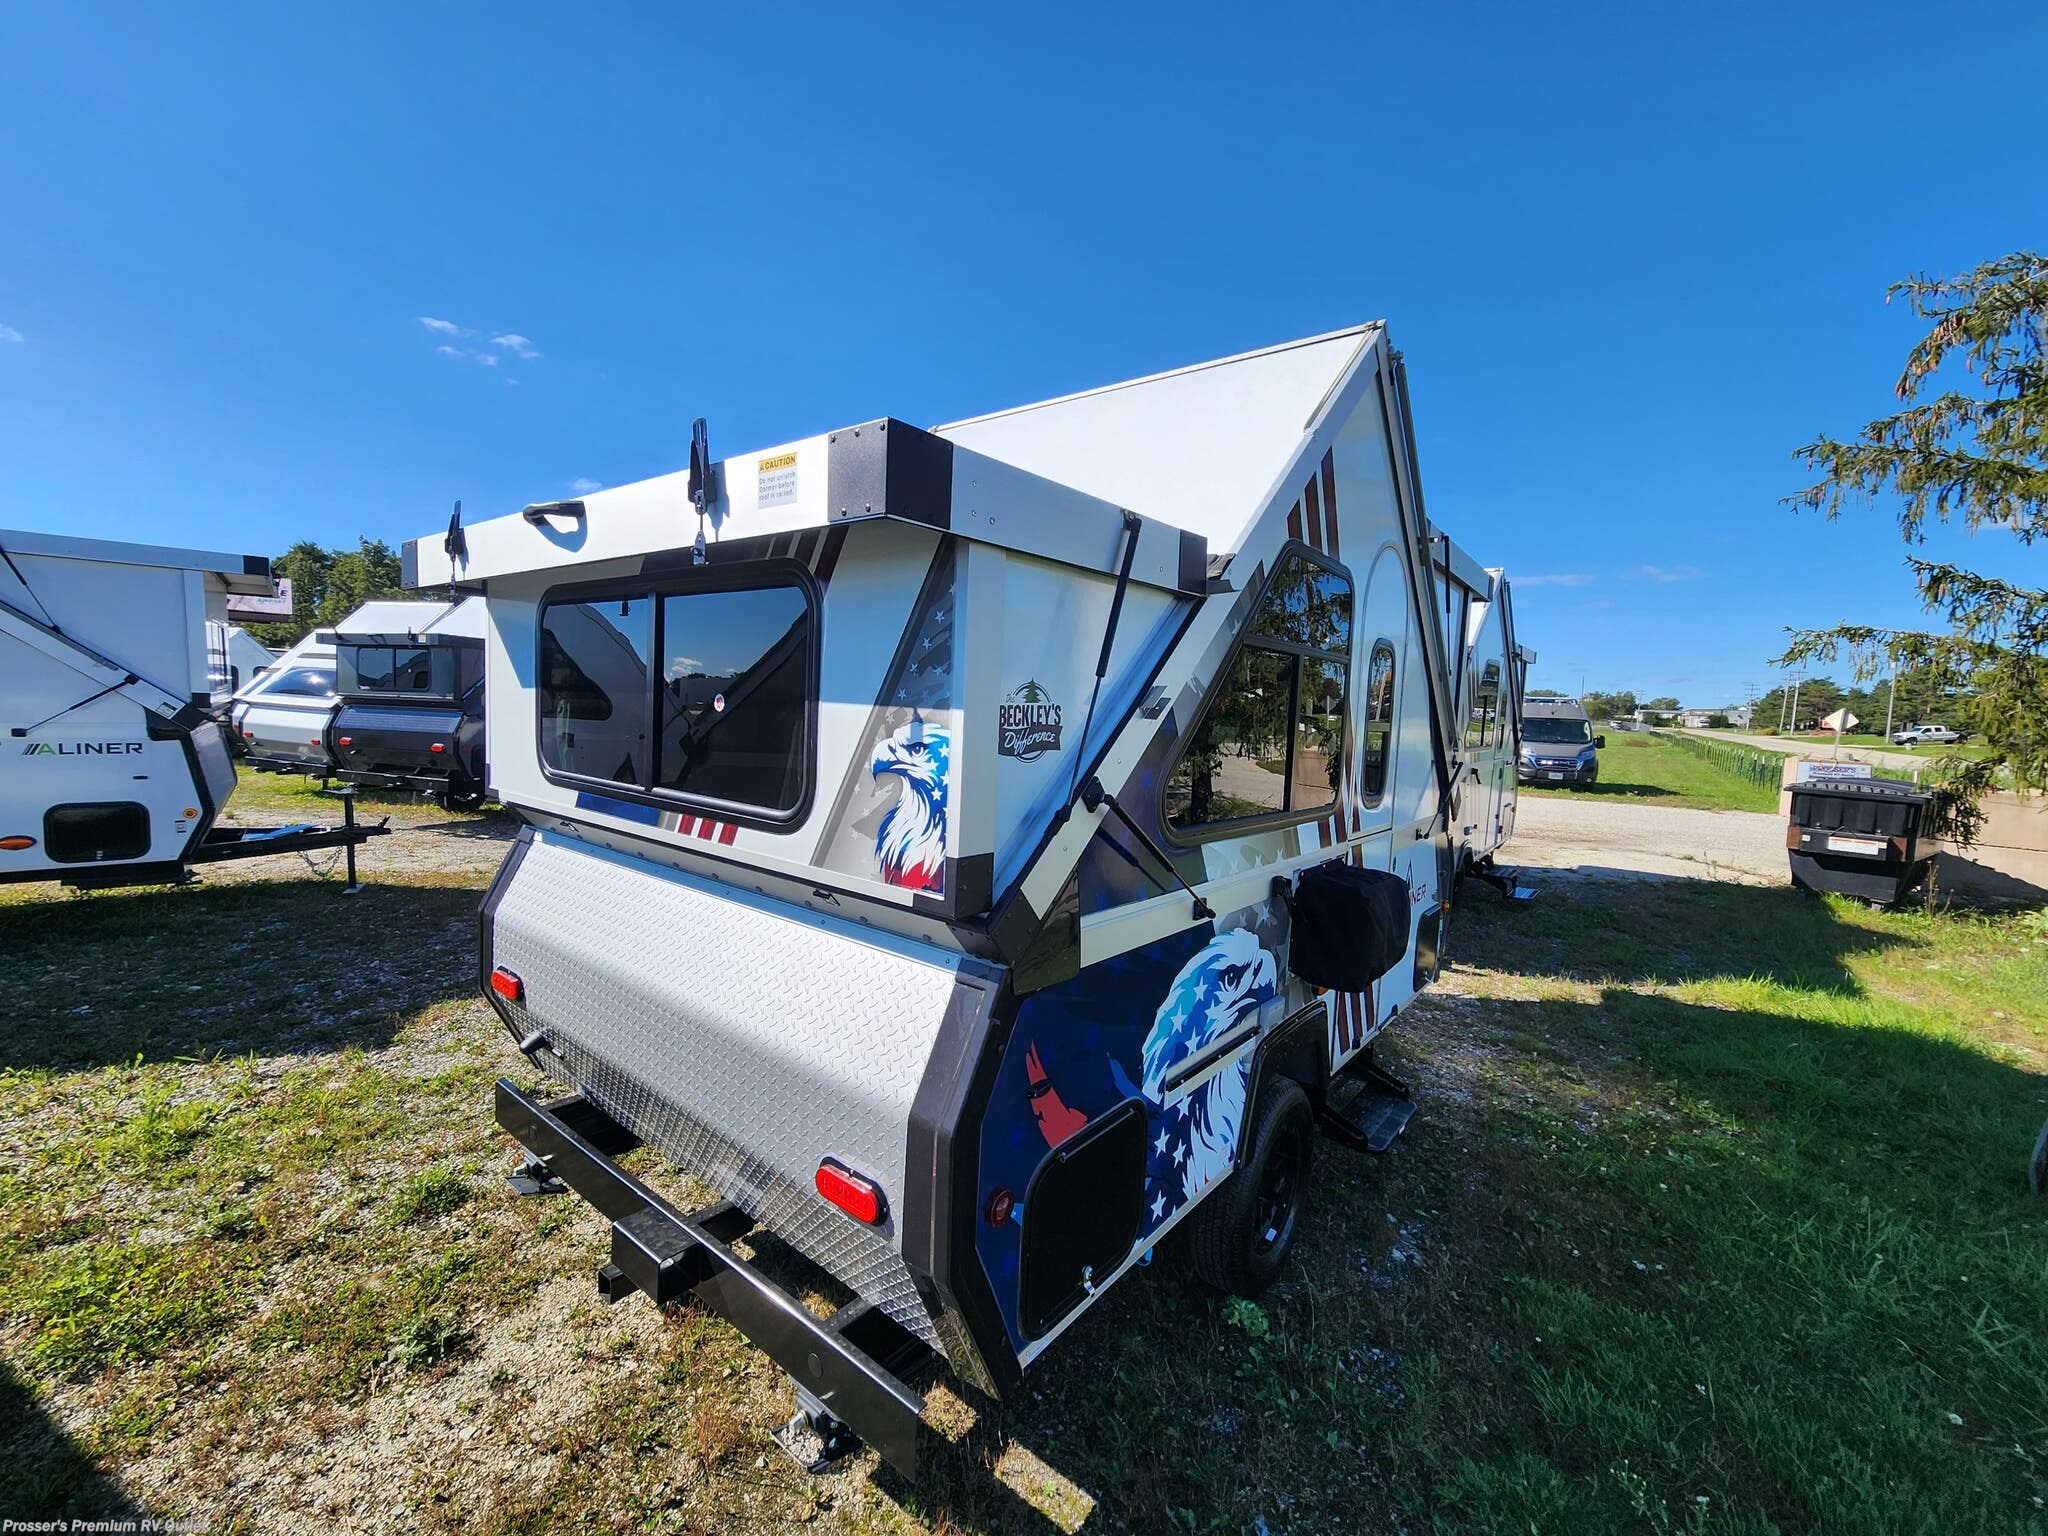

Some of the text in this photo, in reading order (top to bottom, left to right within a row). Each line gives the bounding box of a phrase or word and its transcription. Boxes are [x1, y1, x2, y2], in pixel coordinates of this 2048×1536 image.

[765, 456, 796, 470] CAUTION
[767, 475, 776, 483] not
[778, 480, 795, 489] before
[999, 704, 1062, 727] BECKLEY'S
[1004, 729, 1056, 755] Difference
